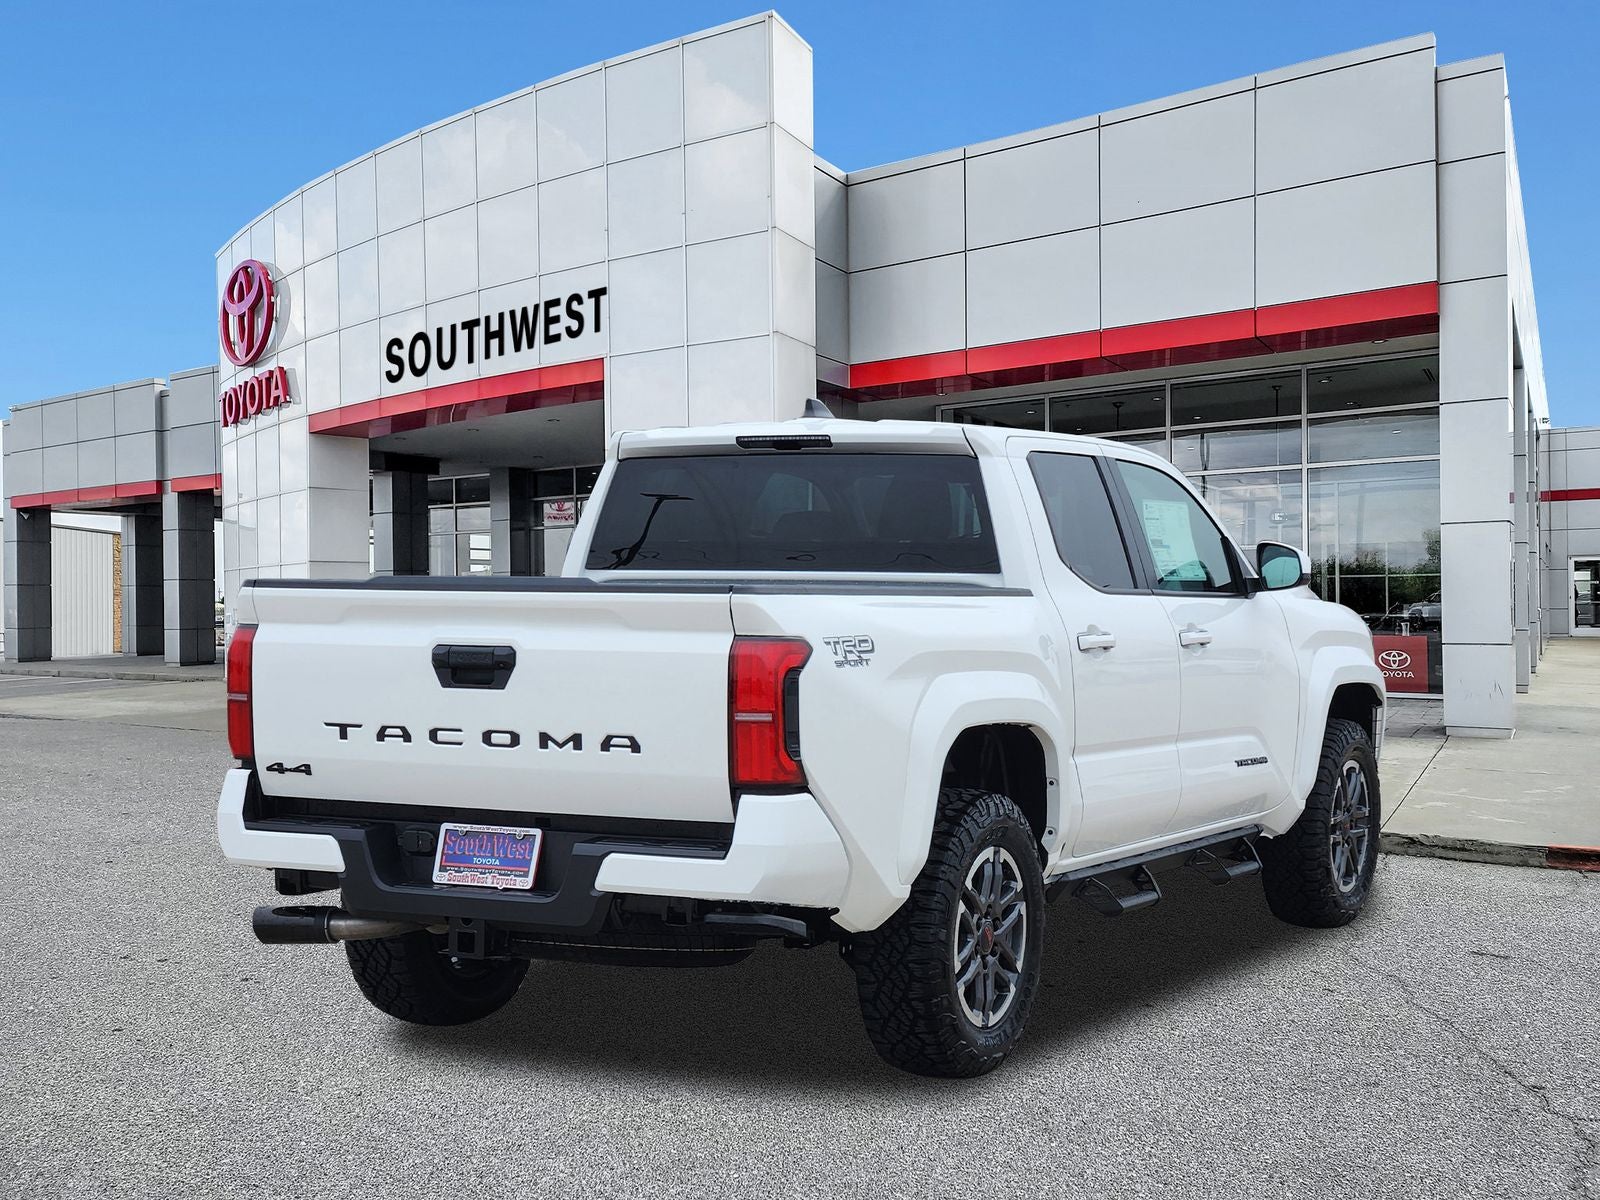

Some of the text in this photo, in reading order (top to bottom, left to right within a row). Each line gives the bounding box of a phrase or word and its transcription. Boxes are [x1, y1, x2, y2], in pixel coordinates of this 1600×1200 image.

[385, 286, 607, 383] SOUTHWEST
[218, 365, 291, 428] TOYOTA
[822, 634, 875, 660] TRD
[834, 658, 871, 668] SPORT
[1381, 670, 1415, 678] OYOTA
[323, 721, 642, 755] TACOMA
[473, 857, 500, 866] TOYOTA
[446, 872, 518, 888] SouthWest Toyota
